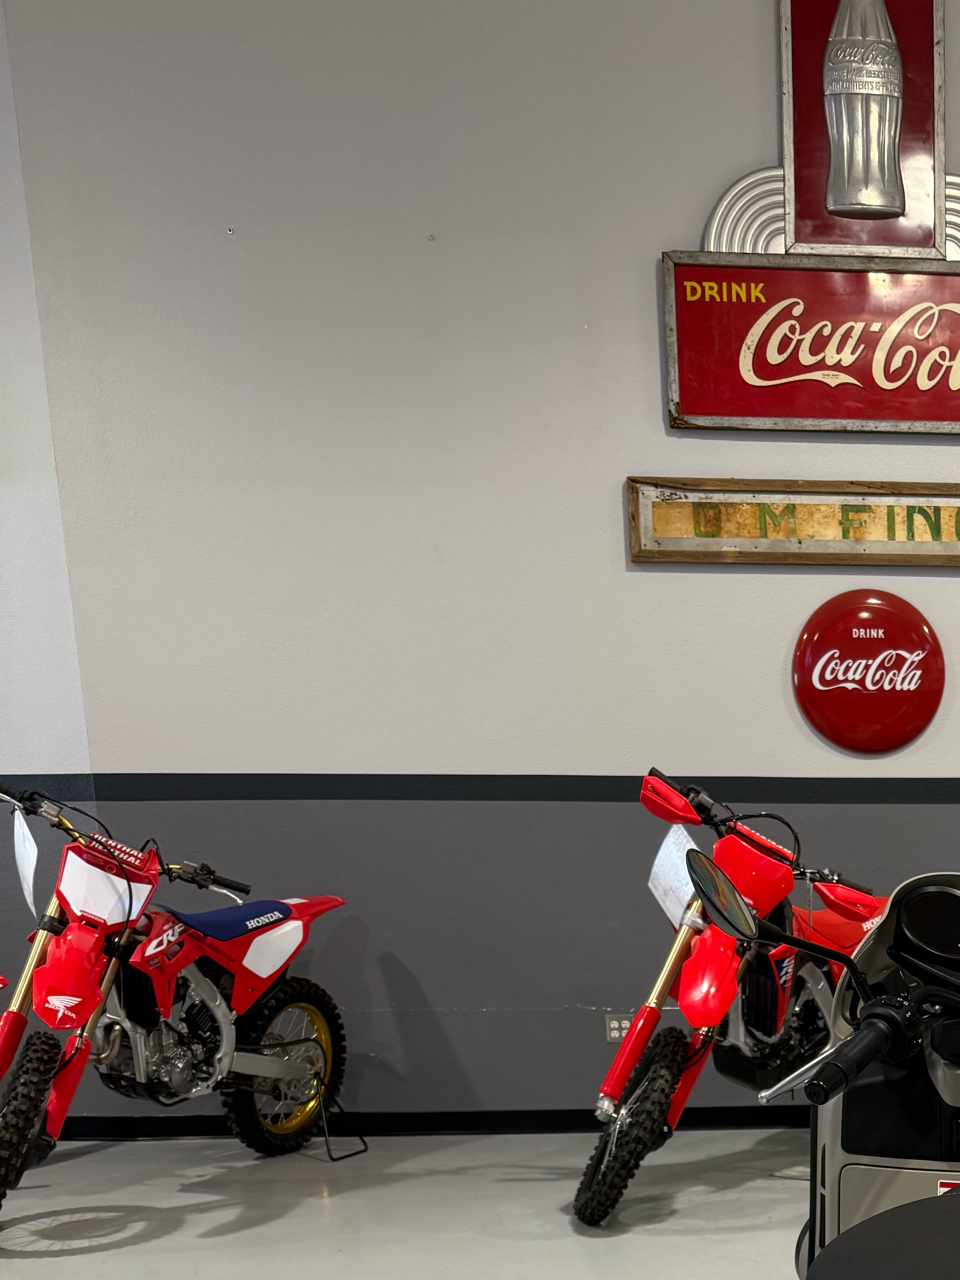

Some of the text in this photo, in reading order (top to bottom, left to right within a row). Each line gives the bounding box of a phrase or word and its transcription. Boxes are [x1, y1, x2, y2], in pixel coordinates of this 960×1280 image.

[683, 280, 767, 303] DRINK
[852, 628, 885, 638] DRINK
[811, 649, 928, 691] Coca-Cola
[245, 911, 284, 930] HONDA
[144, 922, 185, 957] CRF
[44, 1003, 77, 1019] HONDA
